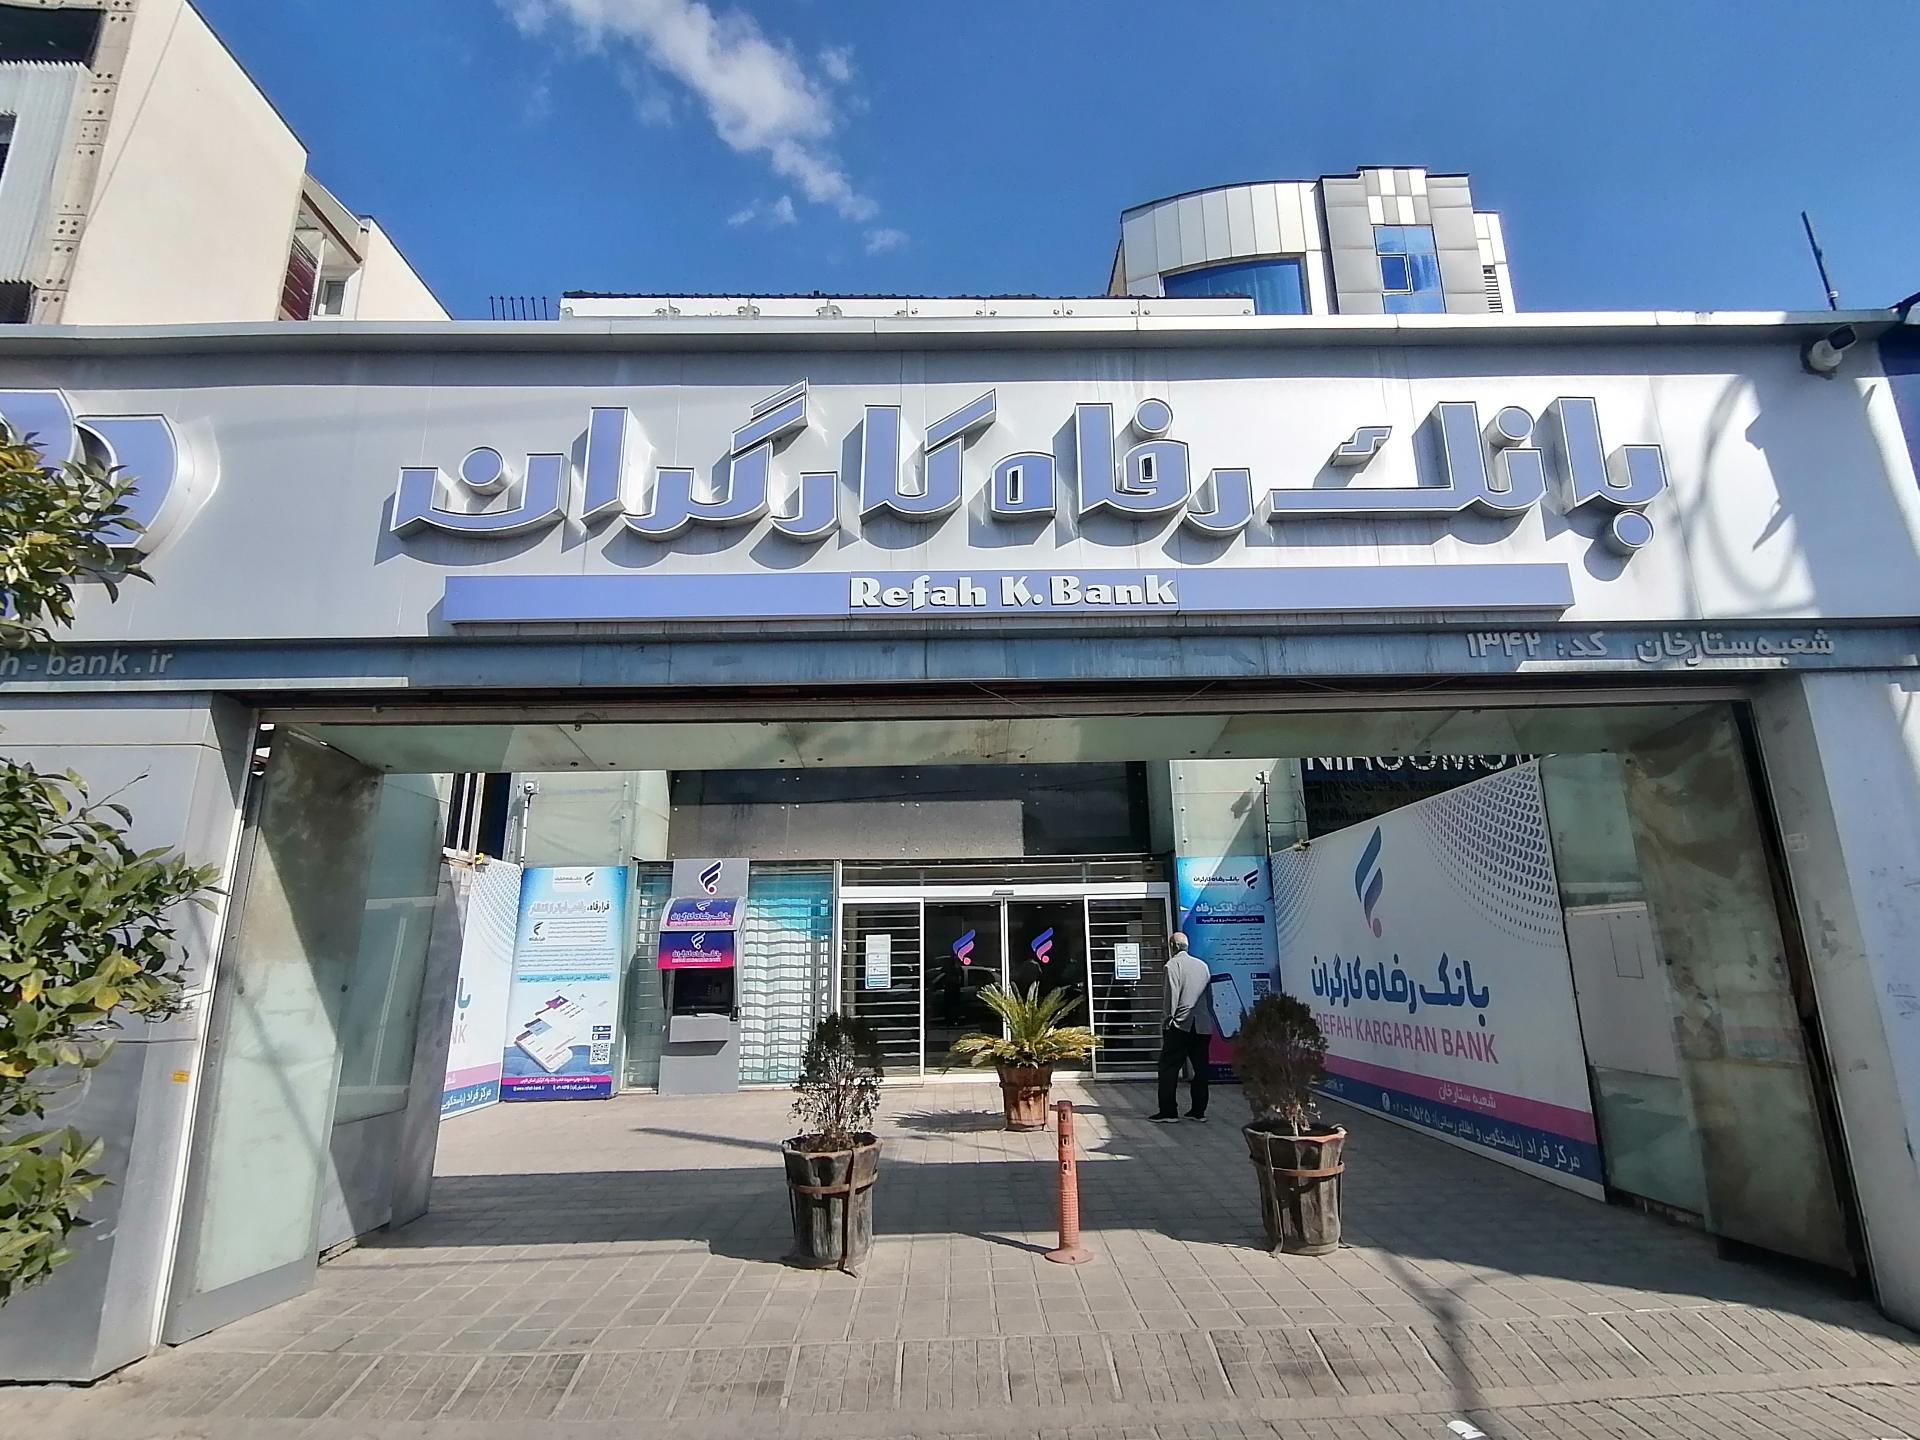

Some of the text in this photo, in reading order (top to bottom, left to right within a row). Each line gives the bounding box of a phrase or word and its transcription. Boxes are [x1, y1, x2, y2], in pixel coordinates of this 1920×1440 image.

[390, 378, 1669, 556] بانک رفاه کارگران
[849, 573, 1179, 612] Refah K. Bank
[1466, 631, 1542, 658] ۱۳۴۲
[1758, 628, 1836, 666] شعبه
[1310, 951, 1490, 1028] بانک رفاه کارگران
[1355, 1017, 1439, 1055] KARGARAN
[1440, 1027, 1500, 1065] BANK
[1472, 1092, 1497, 1111] شعبه
[1553, 1144, 1581, 1173] مرکز
